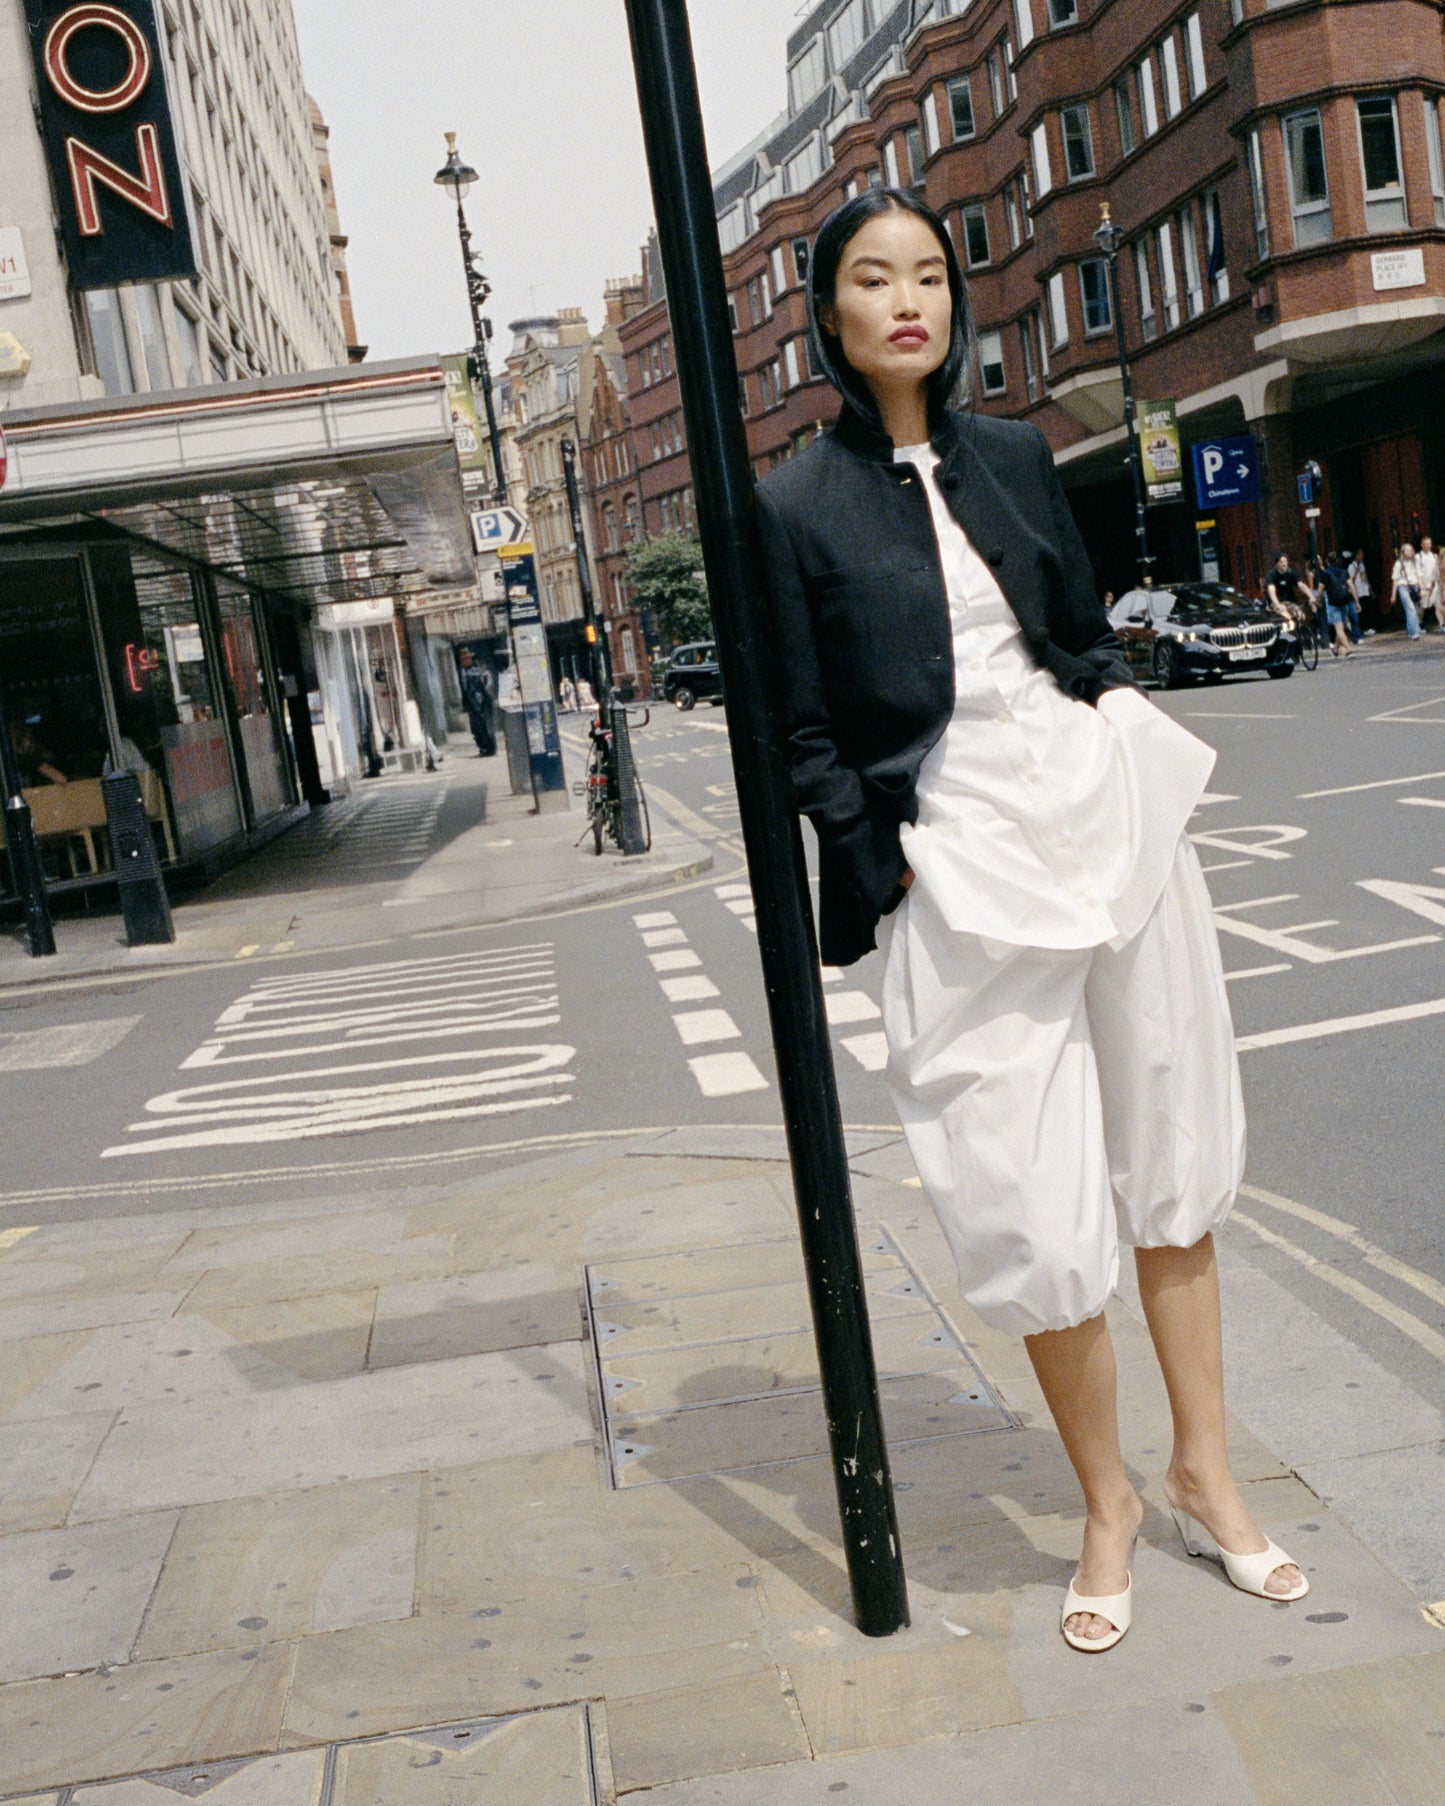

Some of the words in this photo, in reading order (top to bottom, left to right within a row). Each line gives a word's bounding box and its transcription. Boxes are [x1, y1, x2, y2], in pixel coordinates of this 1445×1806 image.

[43, 2, 174, 236] ON
[1203, 450, 1223, 485] P
[479, 515, 497, 537] P
